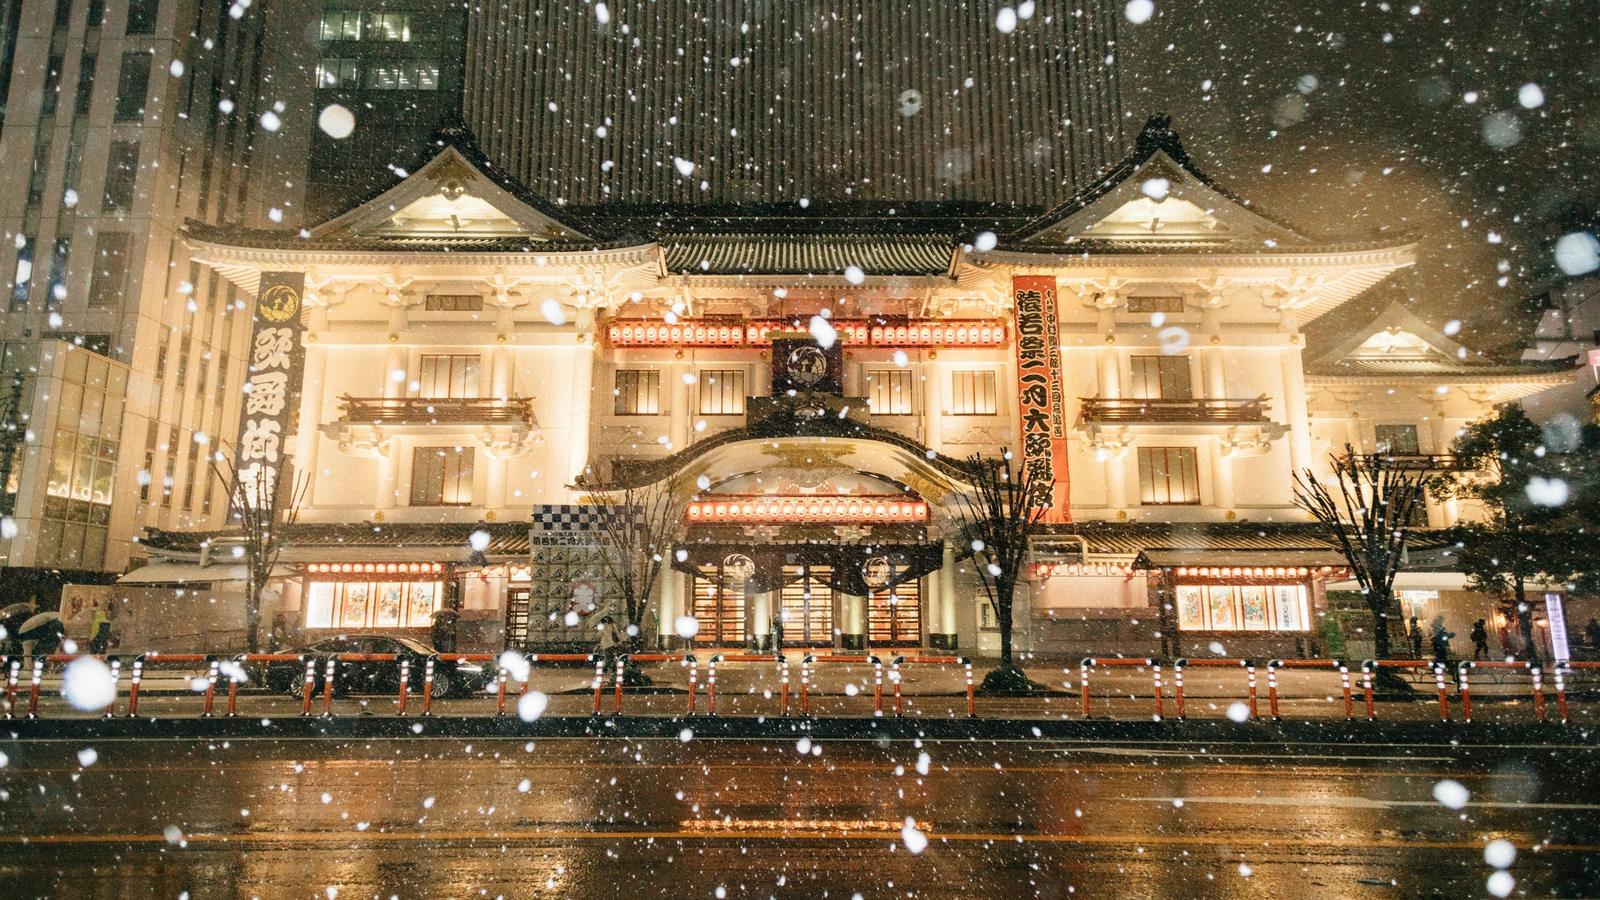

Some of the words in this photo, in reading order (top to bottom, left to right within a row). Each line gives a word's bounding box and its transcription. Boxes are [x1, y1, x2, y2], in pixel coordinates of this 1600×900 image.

[231, 327, 294, 511] 歌舞伎座
[1017, 290, 1055, 508] 猿若祭二月大歌舞伎
